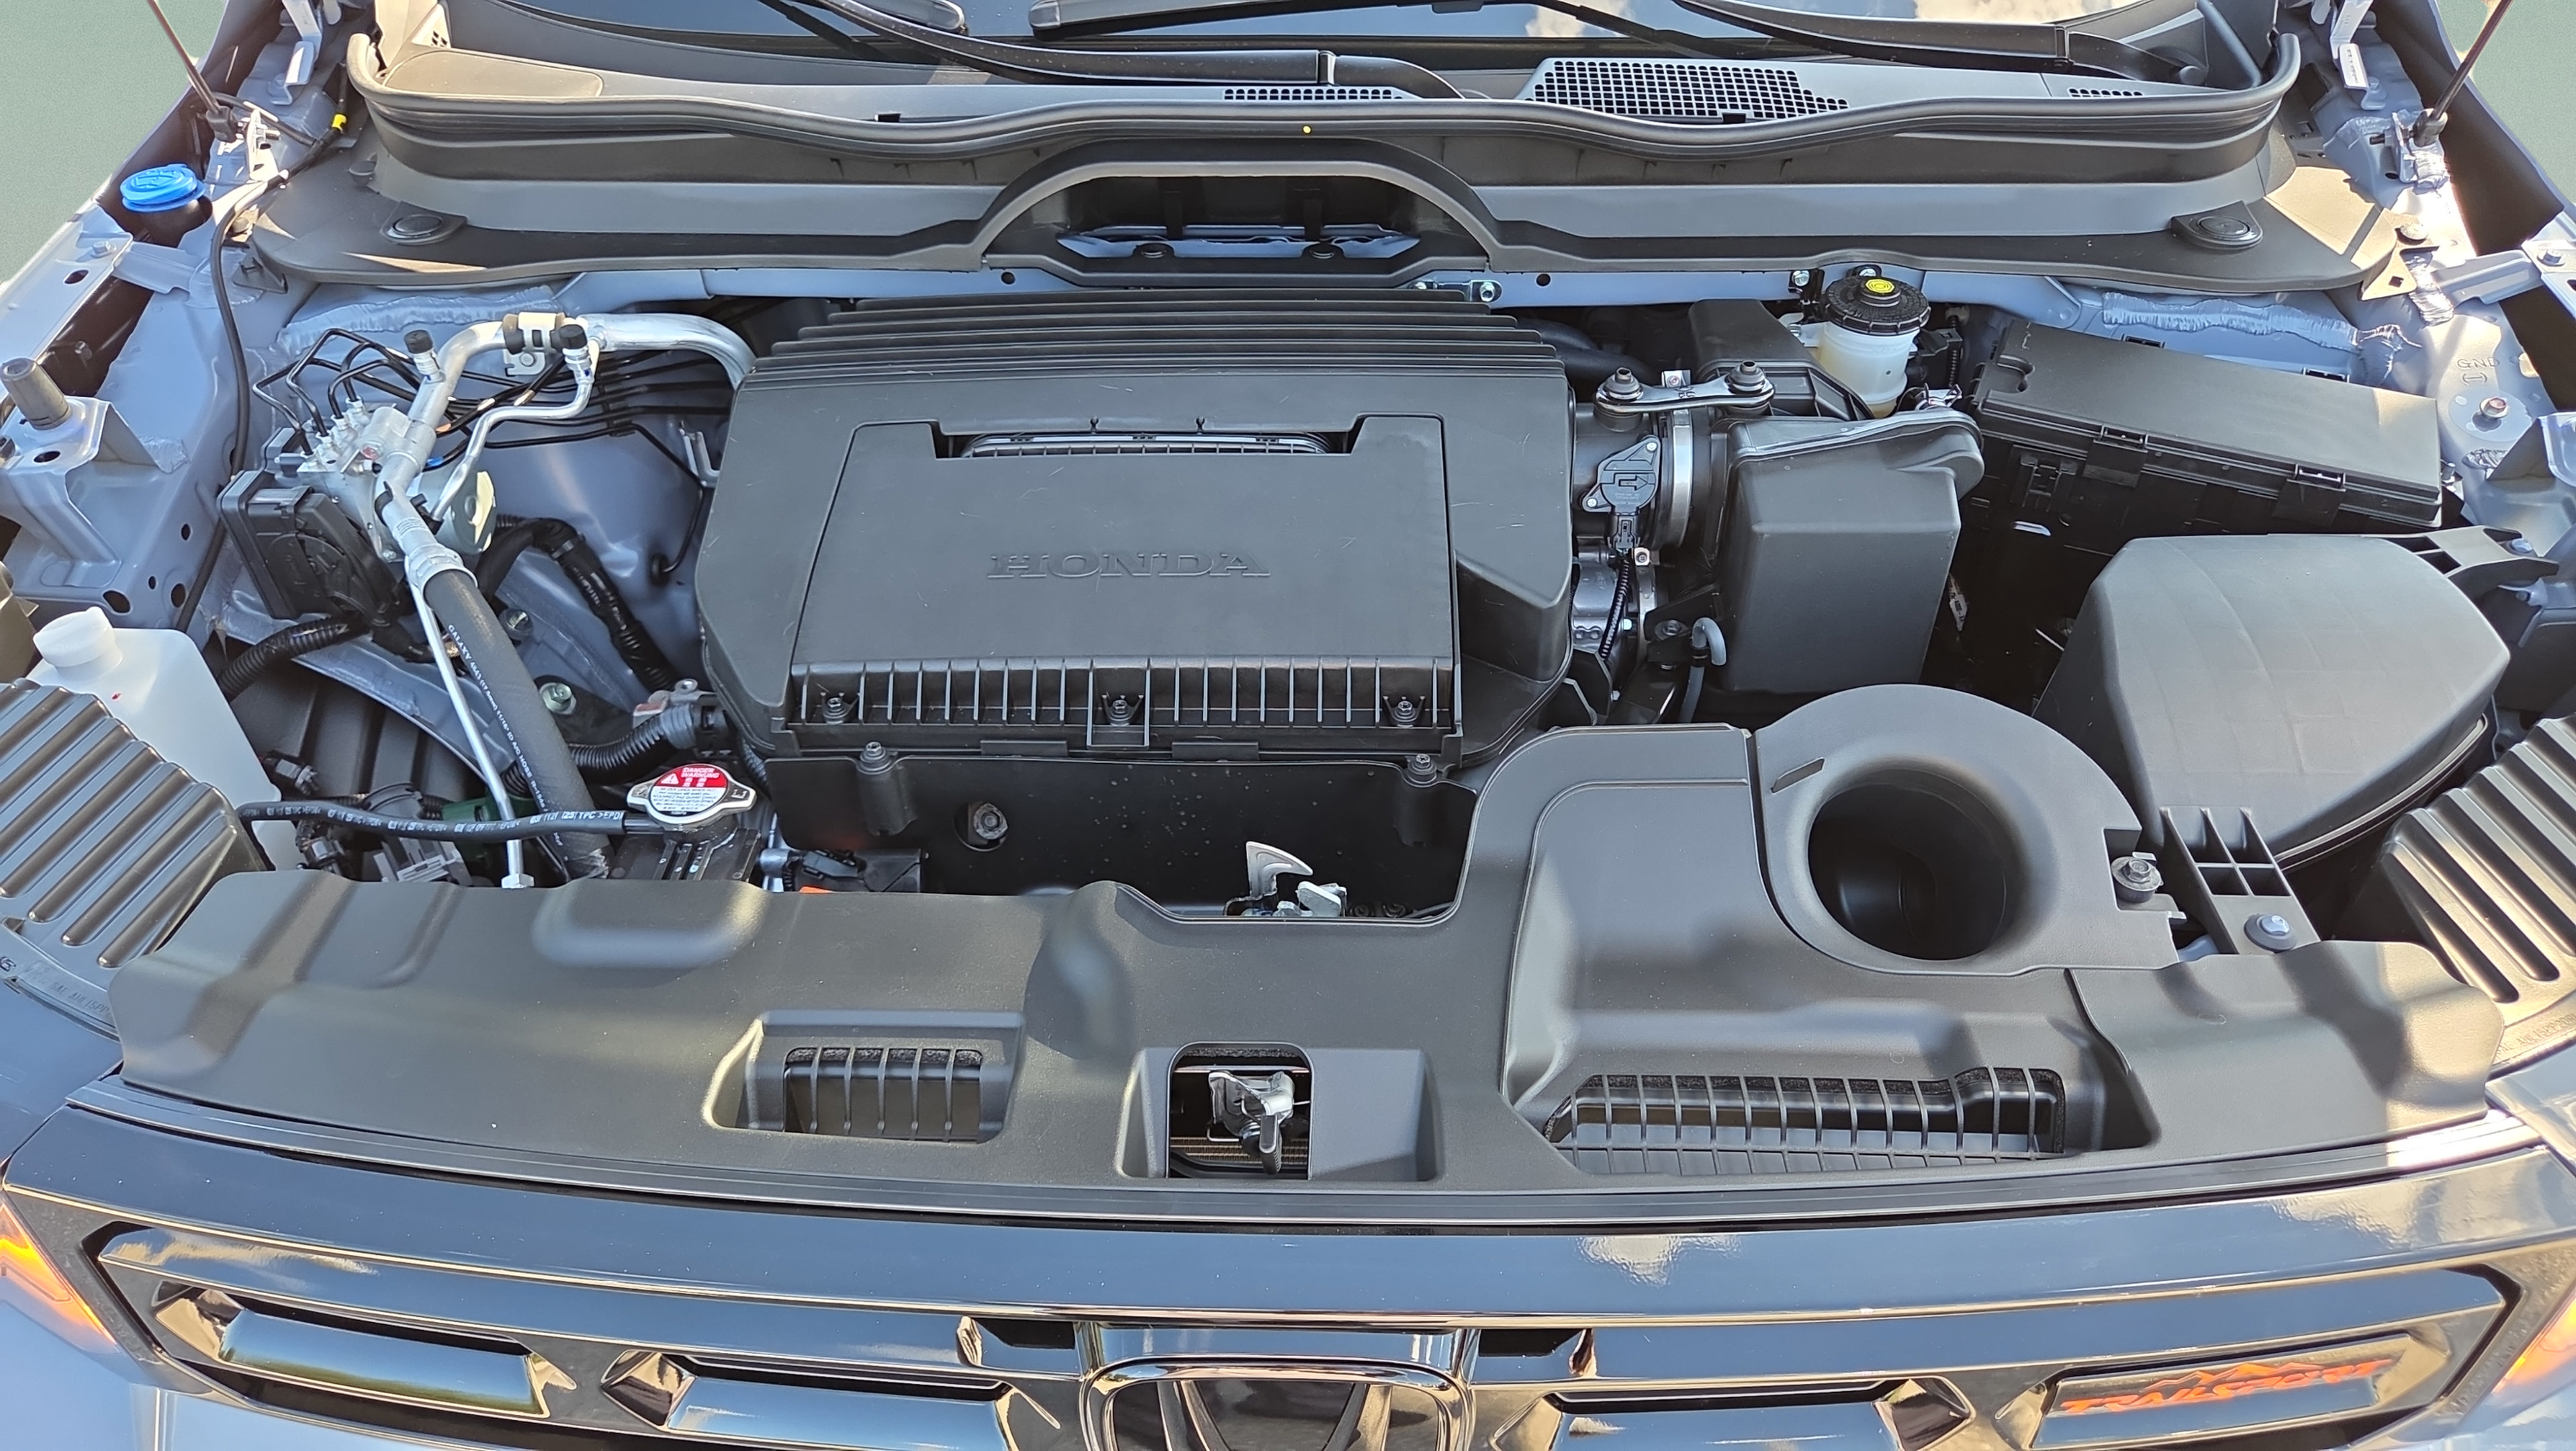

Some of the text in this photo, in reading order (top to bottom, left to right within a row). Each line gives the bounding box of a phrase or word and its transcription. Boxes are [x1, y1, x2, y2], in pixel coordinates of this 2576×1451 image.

[2456, 357, 2500, 369] GND
[987, 553, 1271, 578] HONDA
[447, 624, 471, 660] GALAXY
[520, 756, 533, 778] HOSE
[2060, 1358, 2393, 1415] TRAILSPORT
